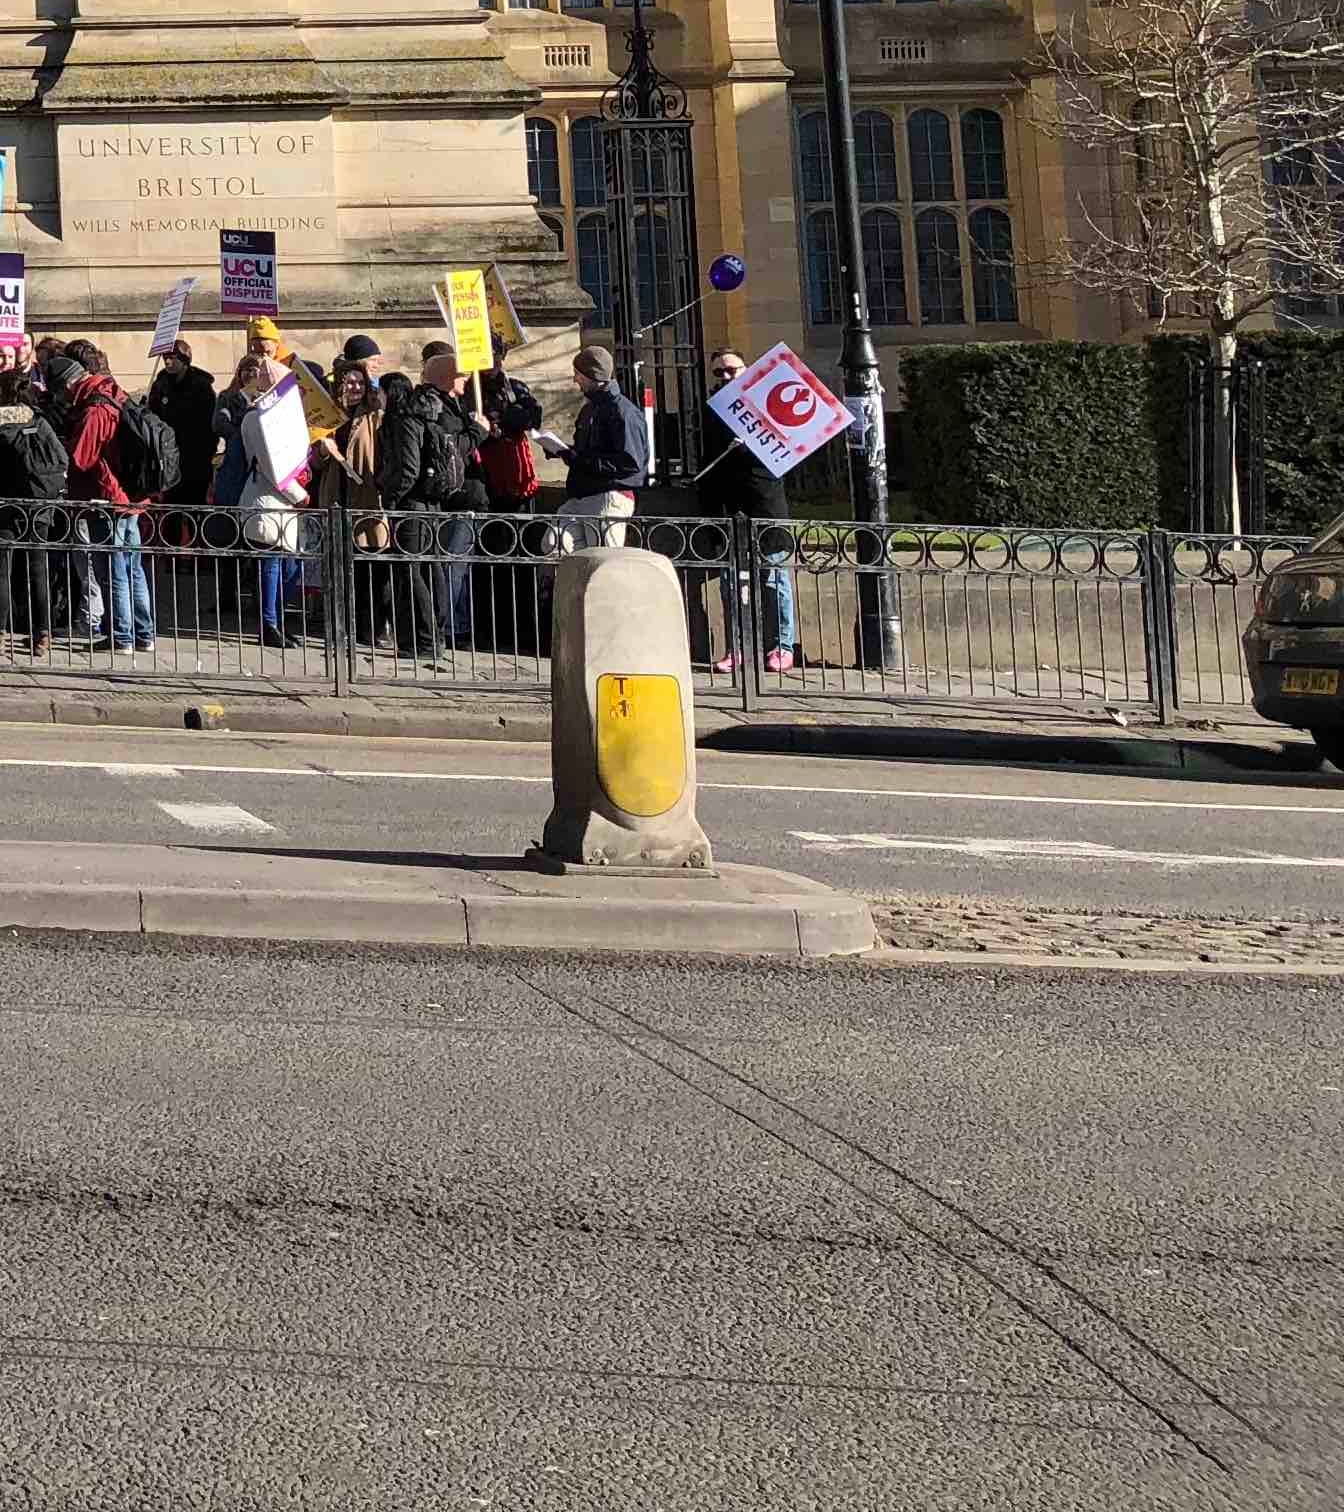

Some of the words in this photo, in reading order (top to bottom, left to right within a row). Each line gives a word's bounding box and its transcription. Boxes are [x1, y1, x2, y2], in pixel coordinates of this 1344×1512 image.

[78, 136, 261, 157] UNIVERSITY
[276, 135, 314, 154] OF
[137, 176, 265, 198] BRISTOL
[72, 219, 121, 233] WILLS
[129, 218, 226, 233] MEMORIAL
[237, 216, 326, 231] BUILDING
[224, 277, 273, 288] OFFICIAL
[224, 288, 273, 300] DISPUTE
[727, 398, 792, 464] RESIST!
